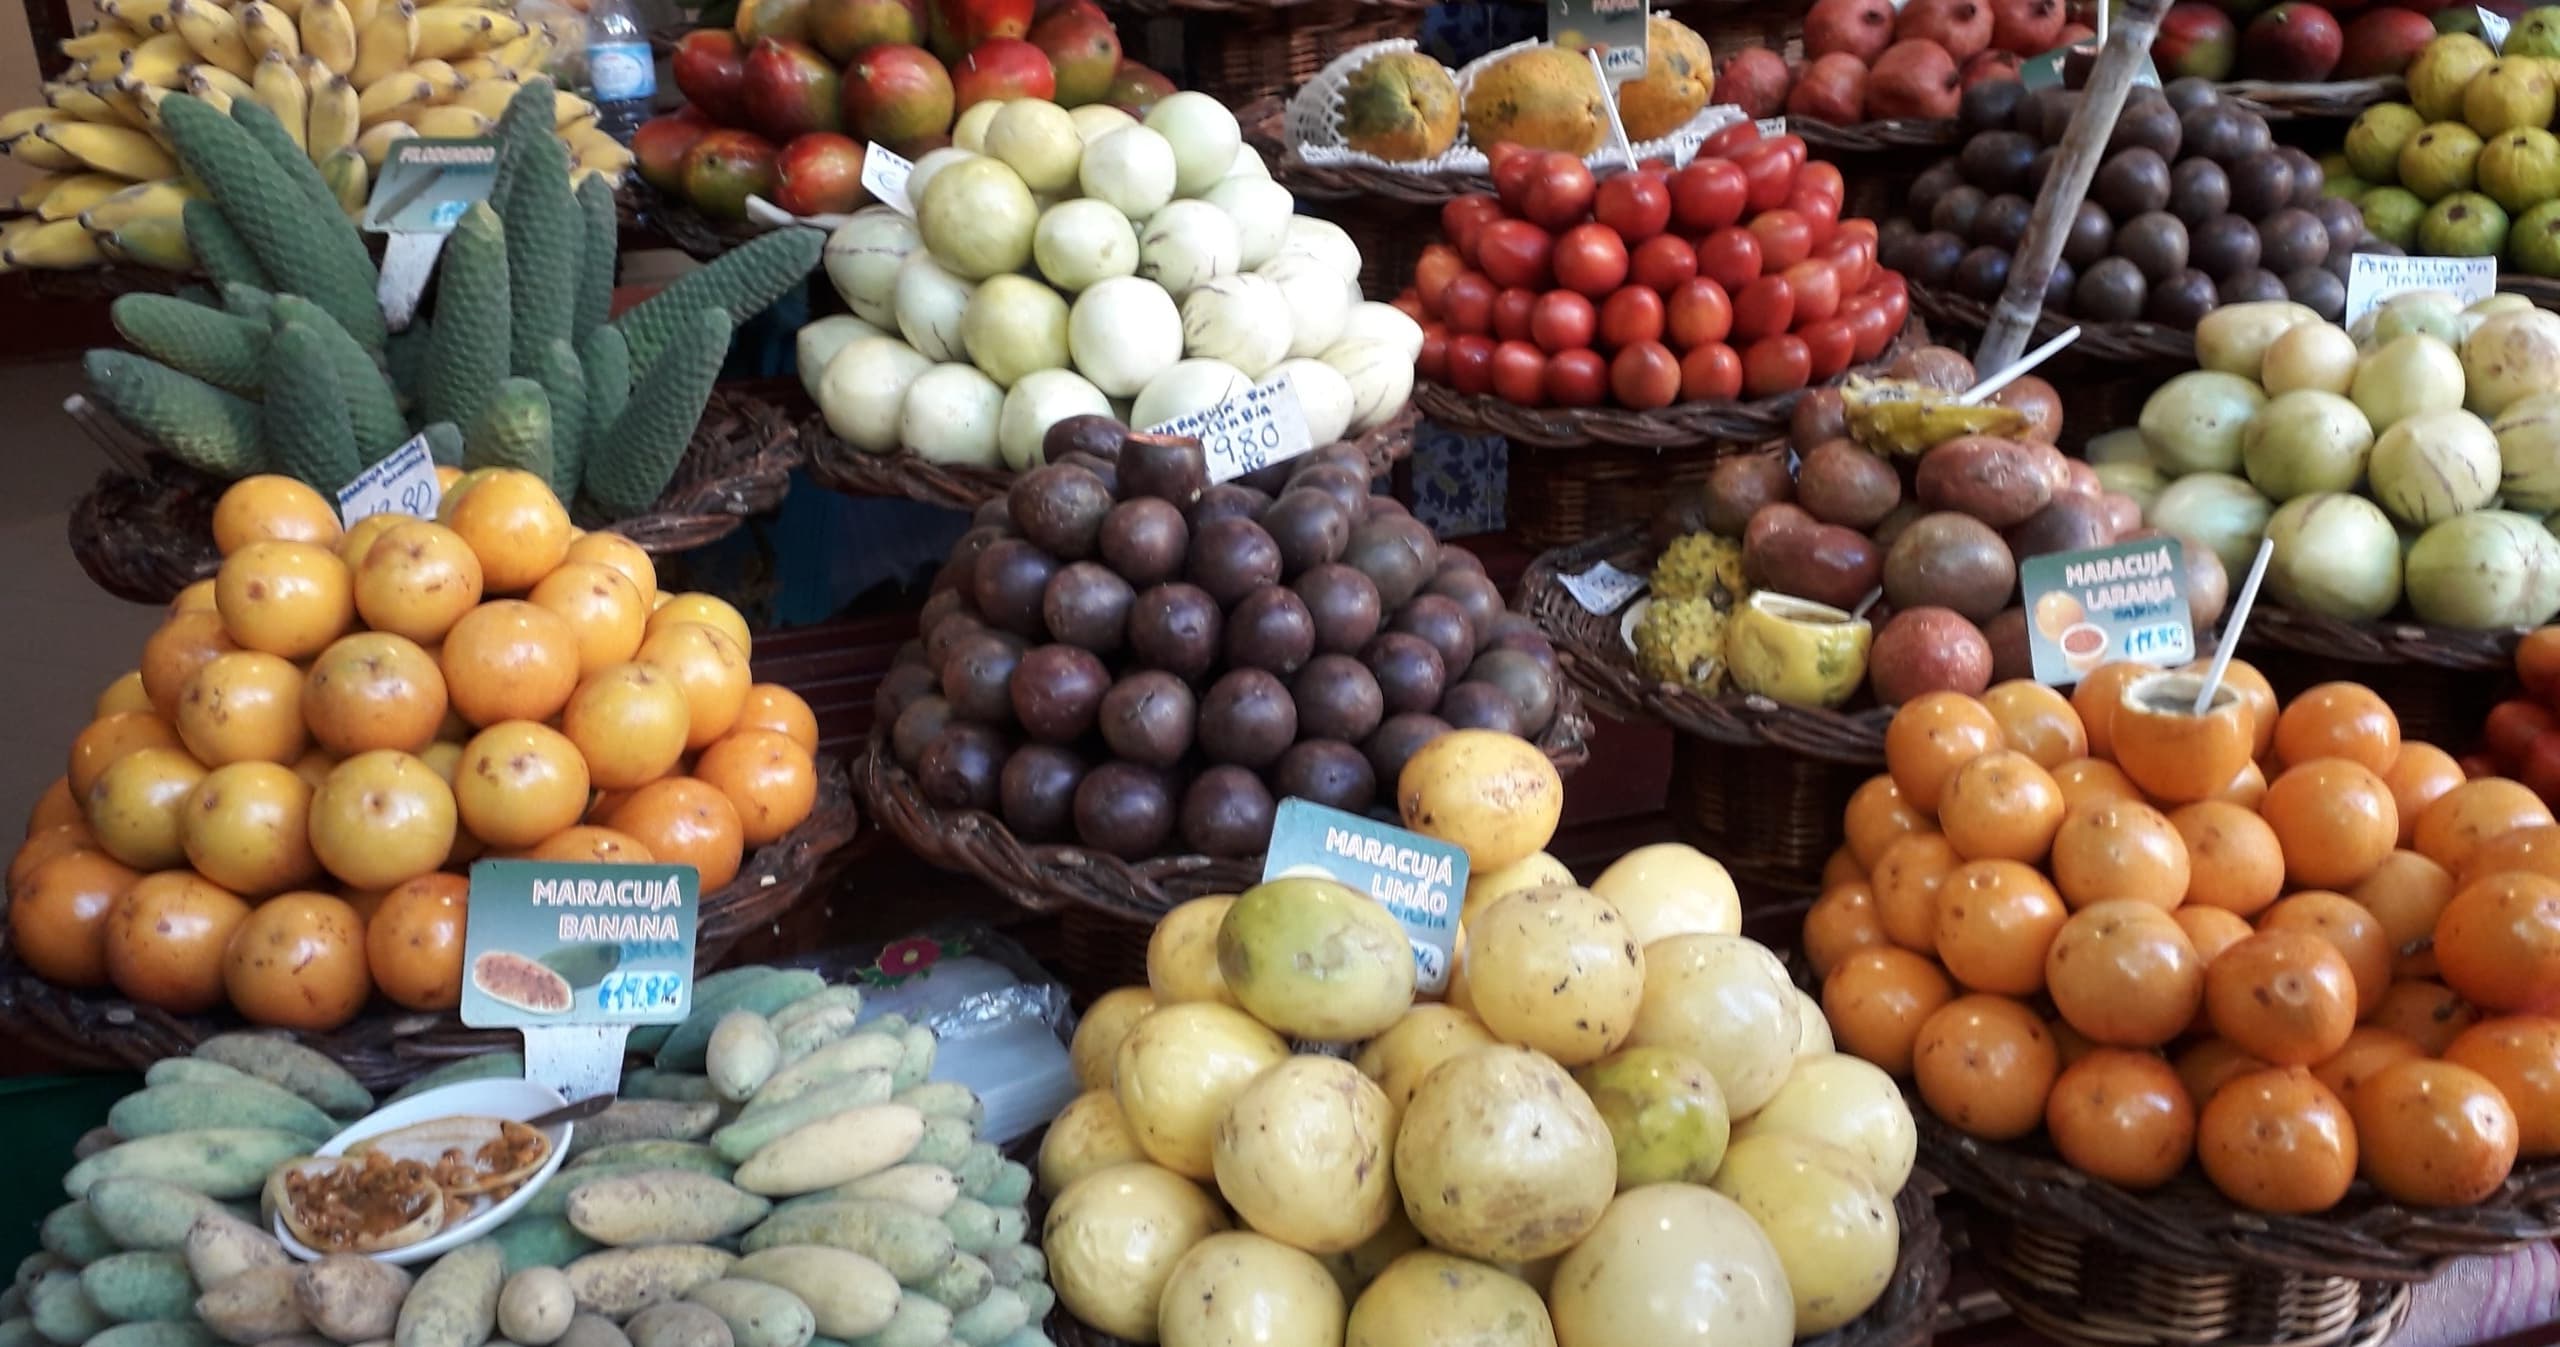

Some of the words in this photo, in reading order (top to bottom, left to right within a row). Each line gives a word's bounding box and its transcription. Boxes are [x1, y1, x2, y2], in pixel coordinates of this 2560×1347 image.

[399, 145, 496, 165] FILODENDRO
[2064, 545, 2173, 588] MARACUJÁ
[2086, 577, 2176, 611] LARANJA
[1325, 826, 1453, 888] MARACUJÁ
[532, 874, 682, 911] MARACUJÁ
[1371, 872, 1449, 916] LIMÃO
[558, 913, 680, 941] BANANA
